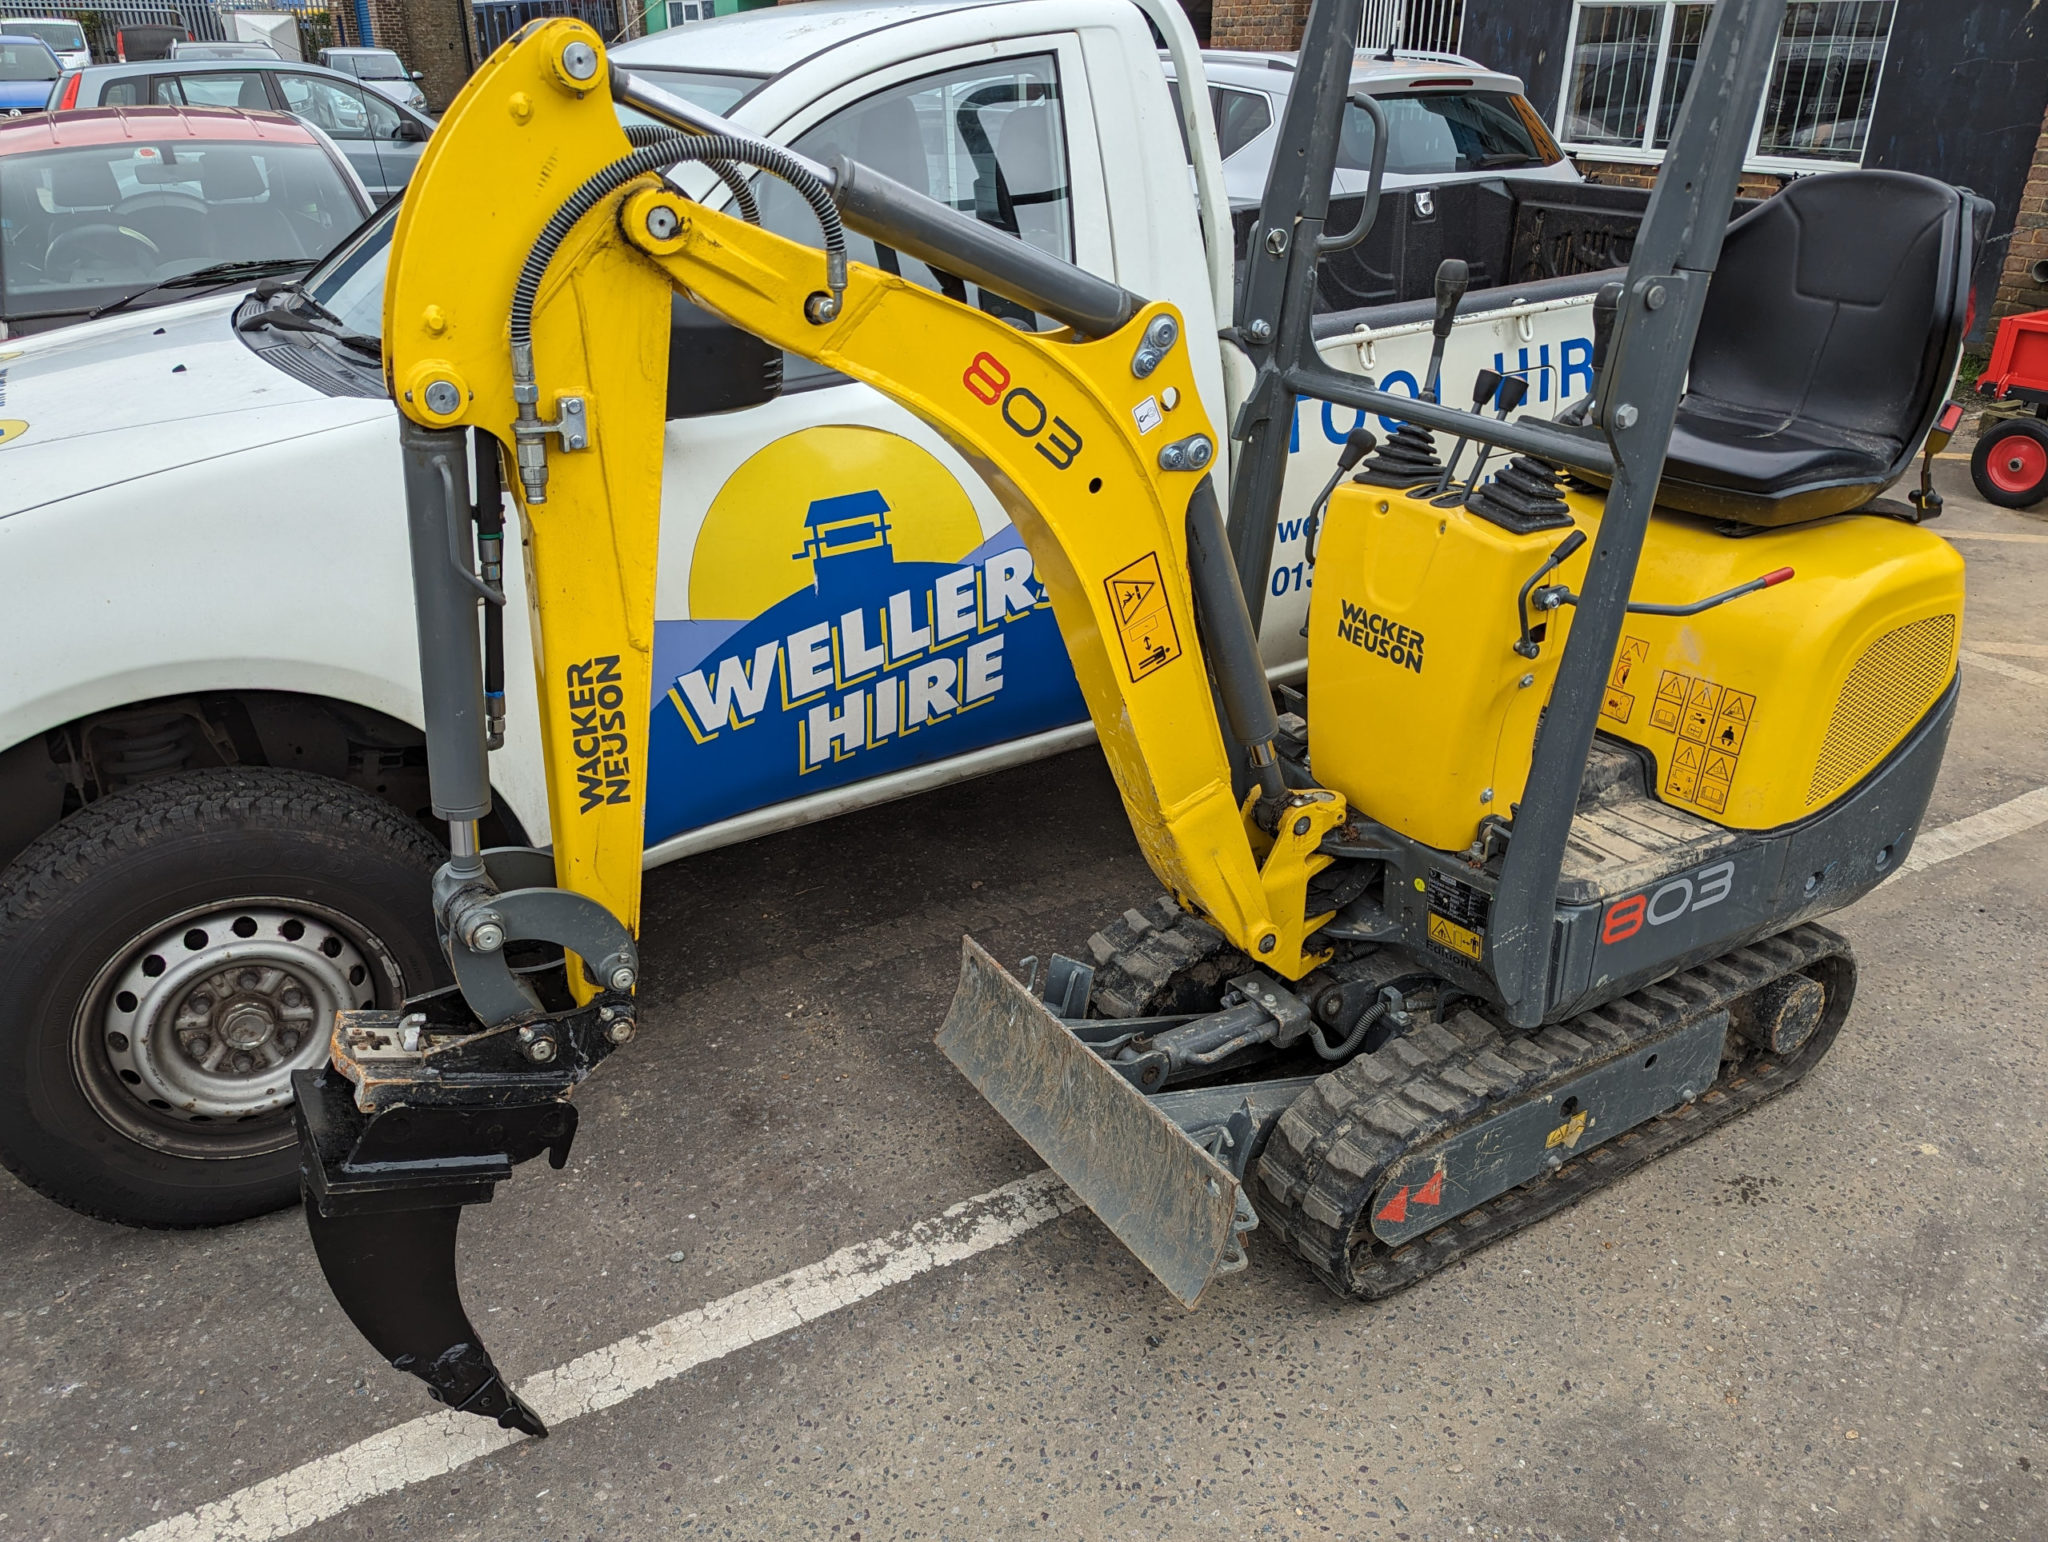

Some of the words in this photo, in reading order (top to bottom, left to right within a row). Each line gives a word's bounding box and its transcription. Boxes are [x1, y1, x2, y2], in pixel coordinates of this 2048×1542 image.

[963, 351, 1083, 470] 803
[671, 547, 1051, 742] WELLER
[1338, 618, 1424, 674] NEUSON
[1341, 598, 1425, 654] WACKER
[566, 658, 605, 815] WACKER
[594, 655, 631, 805] NEUSON
[803, 633, 1005, 772] HIRE
[1426, 939, 1469, 968] Edition
[1602, 860, 1736, 945] 803
